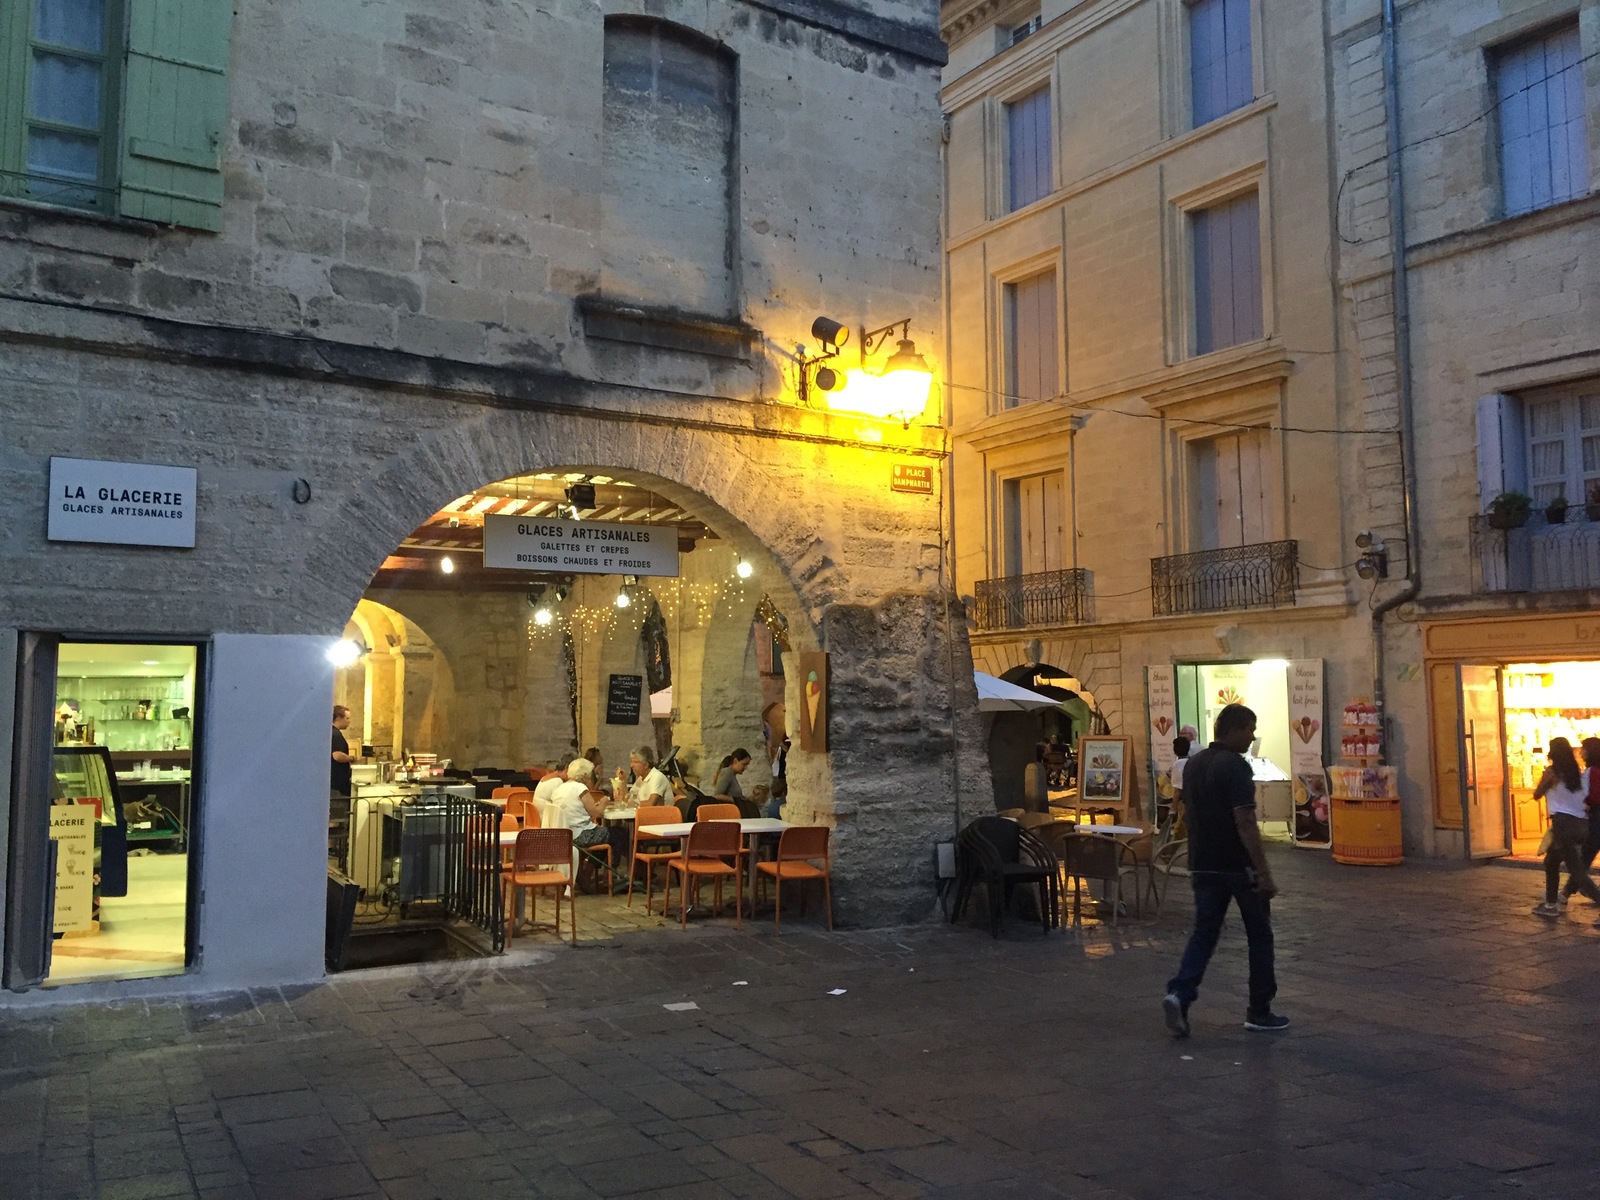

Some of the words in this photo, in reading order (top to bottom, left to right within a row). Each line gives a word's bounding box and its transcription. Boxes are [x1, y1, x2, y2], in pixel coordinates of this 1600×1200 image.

[906, 468, 926, 477] PLACE
[64, 485, 86, 500] LA
[98, 488, 183, 505] GLACERIE
[62, 503, 104, 514] GLACES
[111, 506, 183, 519] ARTISANALES
[517, 523, 564, 537] GLACES
[571, 527, 650, 542] ARTISANALES
[540, 542, 580, 552] GALETTES
[585, 544, 596, 553] ET
[600, 545, 630, 555] CREPES
[516, 553, 558, 564] BOISSONS
[563, 556, 599, 566] CHAUDES
[603, 558, 613, 567] ET
[618, 559, 651, 569] FROIDES
[49, 818, 85, 827] LACERIE
